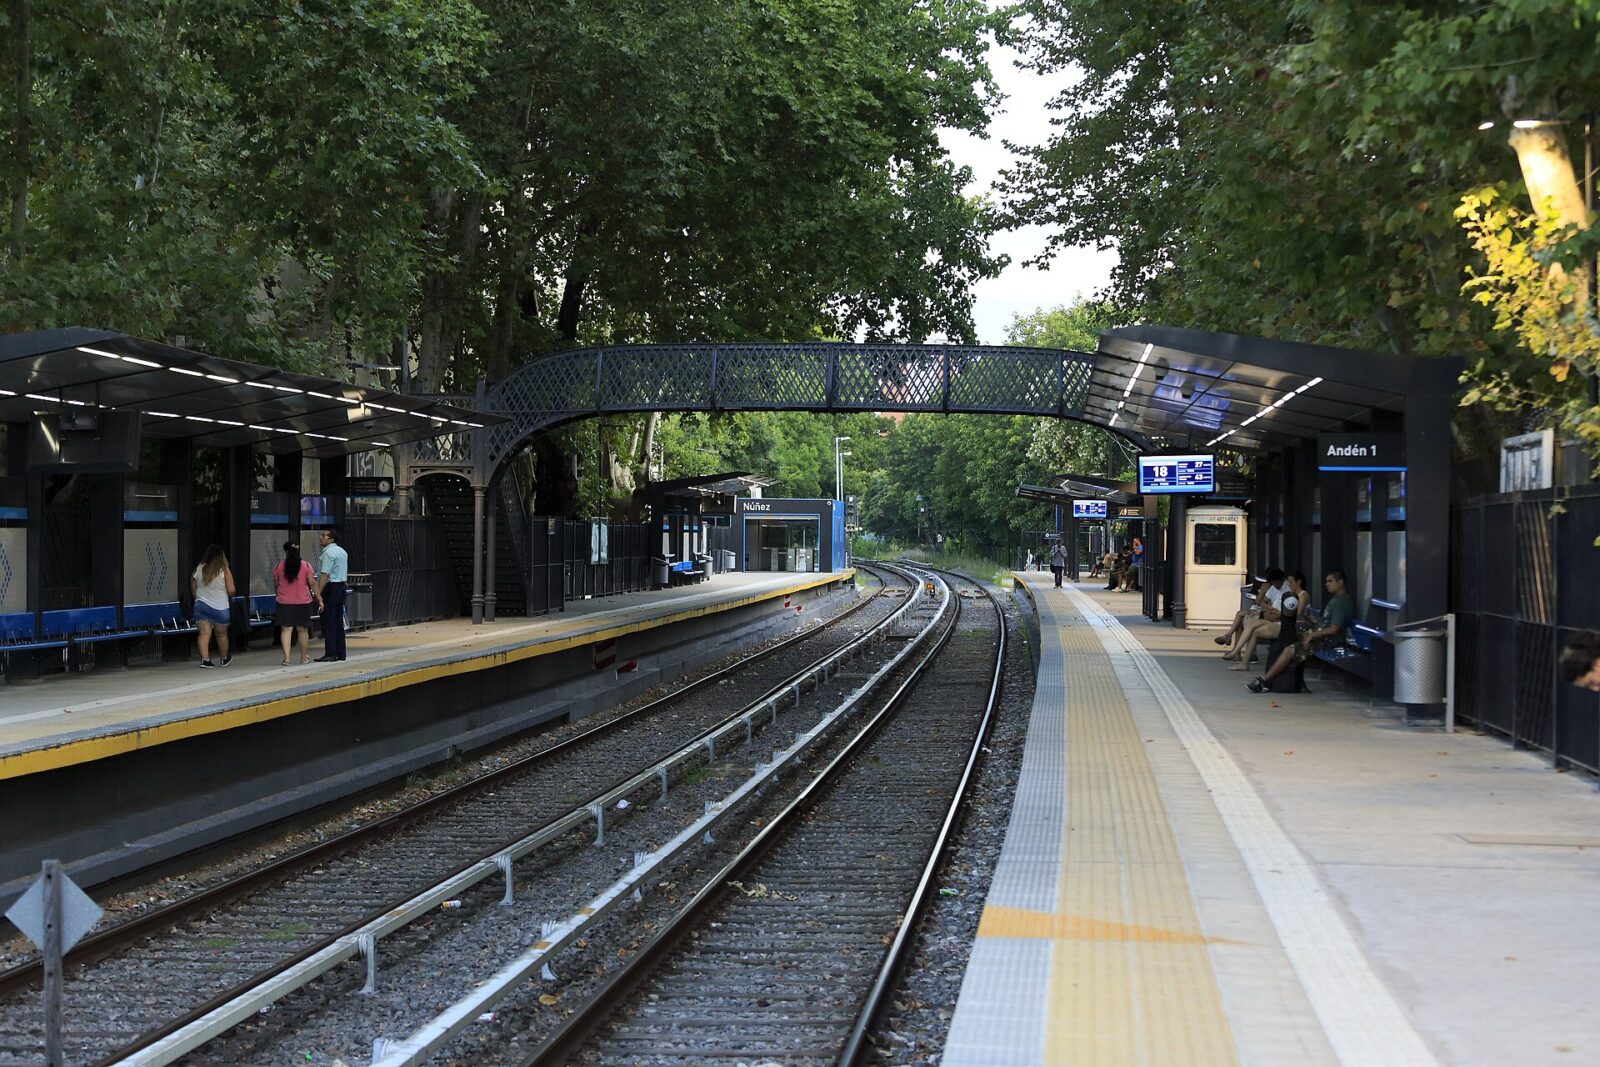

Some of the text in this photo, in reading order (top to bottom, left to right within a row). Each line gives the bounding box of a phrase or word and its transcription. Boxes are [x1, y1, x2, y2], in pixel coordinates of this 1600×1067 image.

[1327, 444, 1377, 456] Andén 1
[1153, 466, 1168, 478] 18
[744, 501, 771, 511] Núñez
